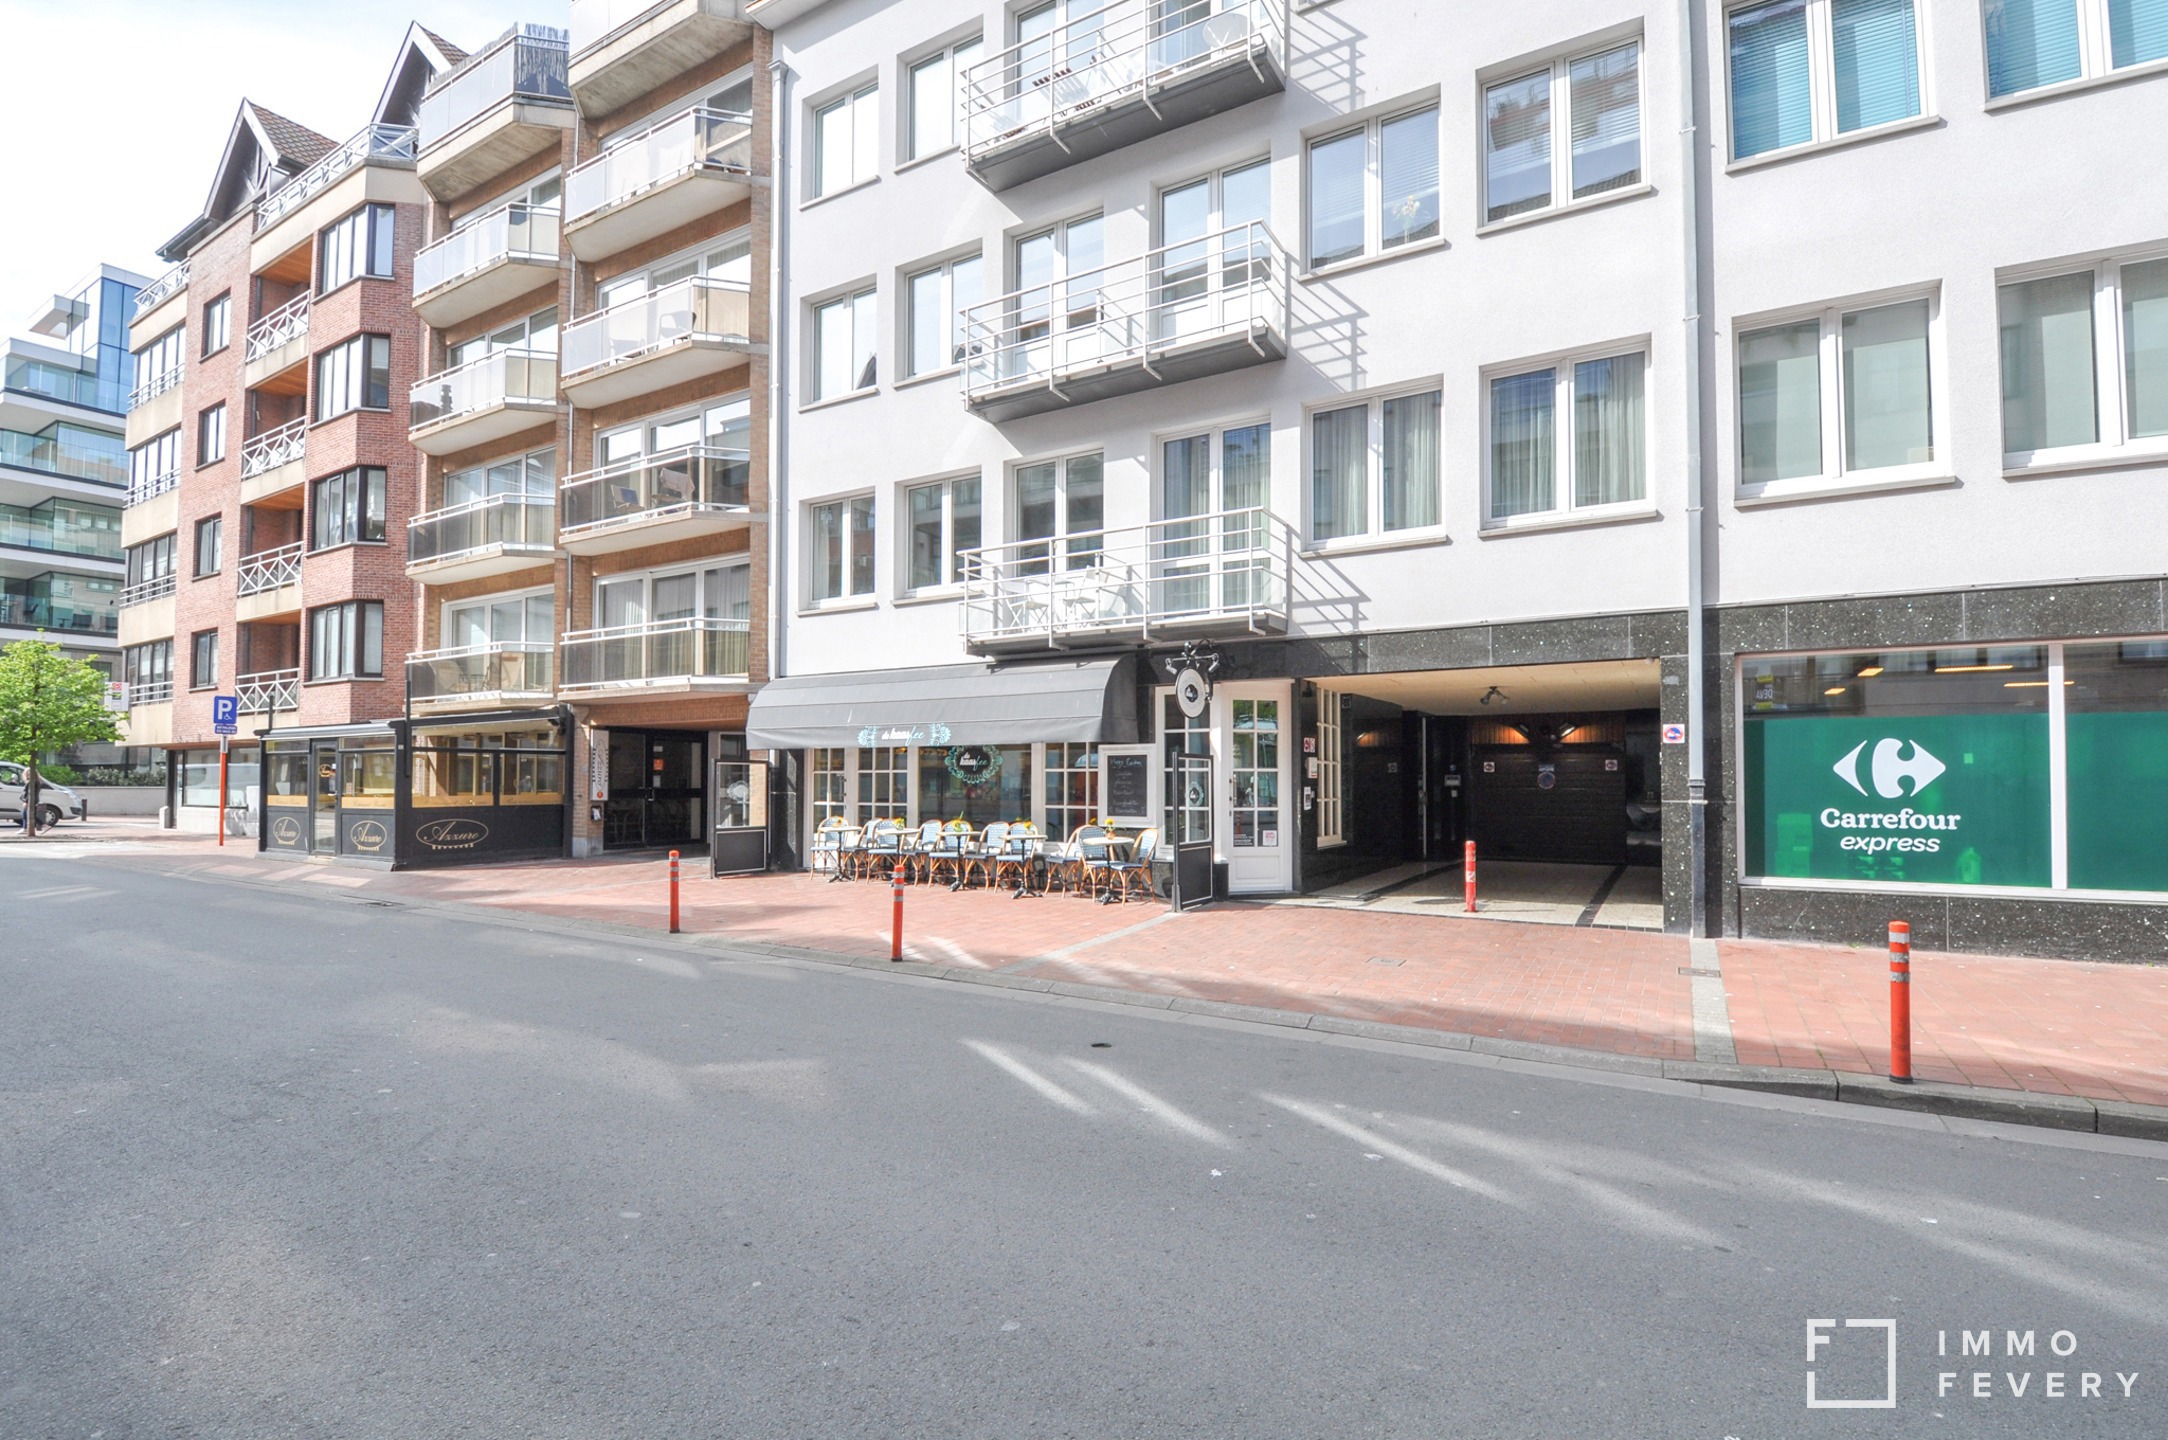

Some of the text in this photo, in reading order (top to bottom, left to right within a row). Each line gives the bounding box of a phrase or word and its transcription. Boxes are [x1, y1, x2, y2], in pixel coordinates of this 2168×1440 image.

[217, 699, 233, 720] P
[1820, 807, 1962, 830] Carrefour
[1840, 836, 1942, 855] express
